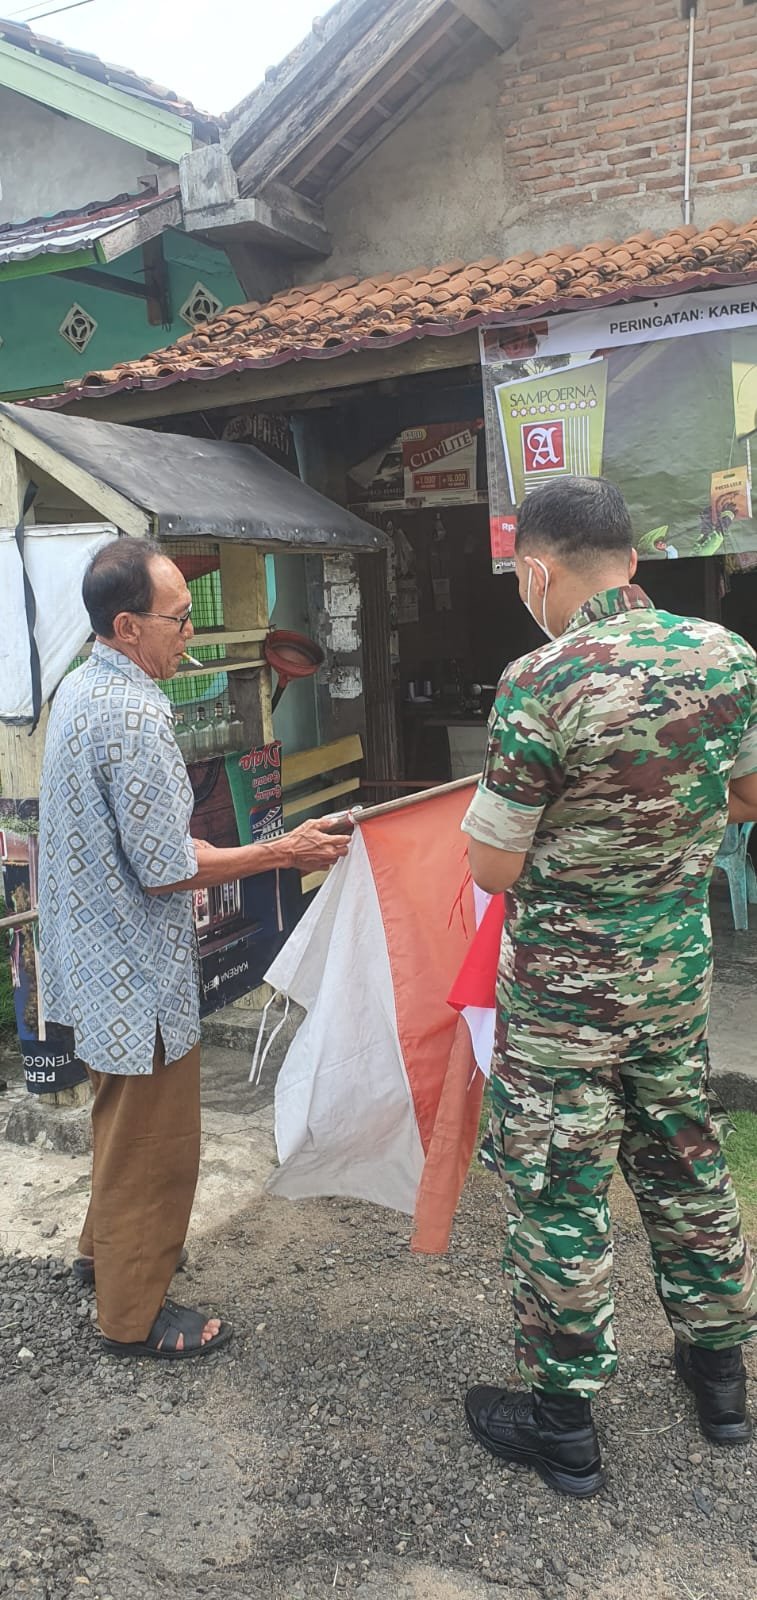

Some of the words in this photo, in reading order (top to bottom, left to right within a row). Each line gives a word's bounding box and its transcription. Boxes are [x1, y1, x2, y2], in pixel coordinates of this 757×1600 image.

[609, 309, 704, 334] PERINGATAN:
[510, 384, 597, 407] SAMPOERNA
[527, 427, 560, 468] A
[220, 960, 249, 983] KARENA
